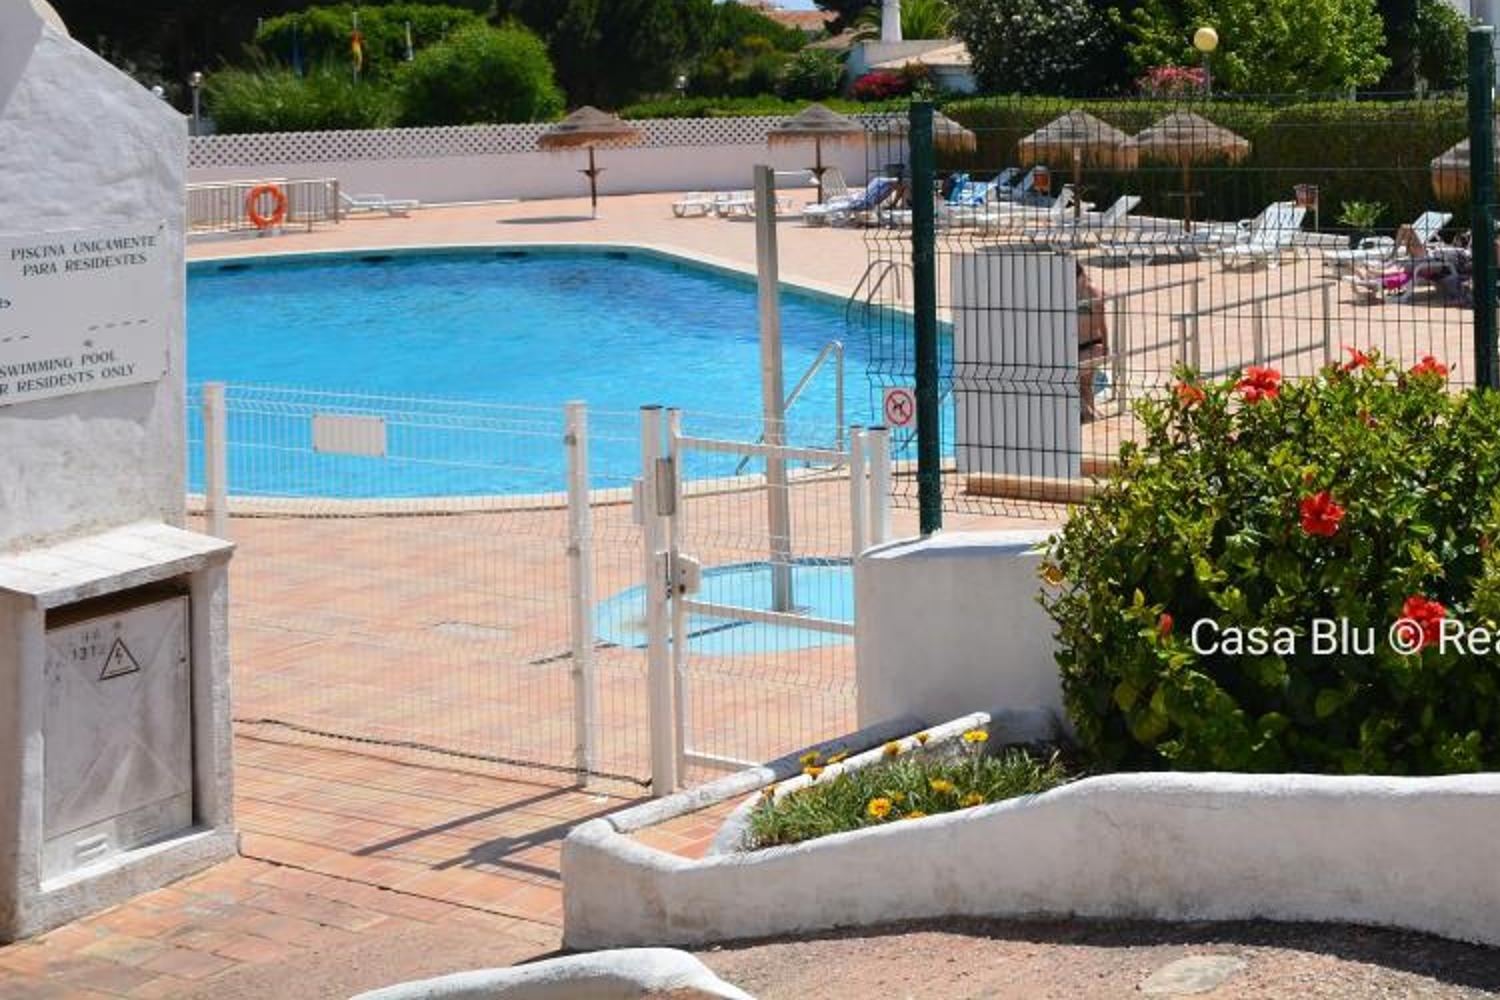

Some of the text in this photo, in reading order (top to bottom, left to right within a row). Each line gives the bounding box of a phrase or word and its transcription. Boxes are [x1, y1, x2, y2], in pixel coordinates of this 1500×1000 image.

[11, 244, 65, 260] PISCINA
[23, 252, 147, 276] PARA RESIDENTES
[0, 350, 116, 377] SWIMMING POOL
[17, 371, 94, 392] RESIDENTS
[102, 363, 136, 378] ONLY
